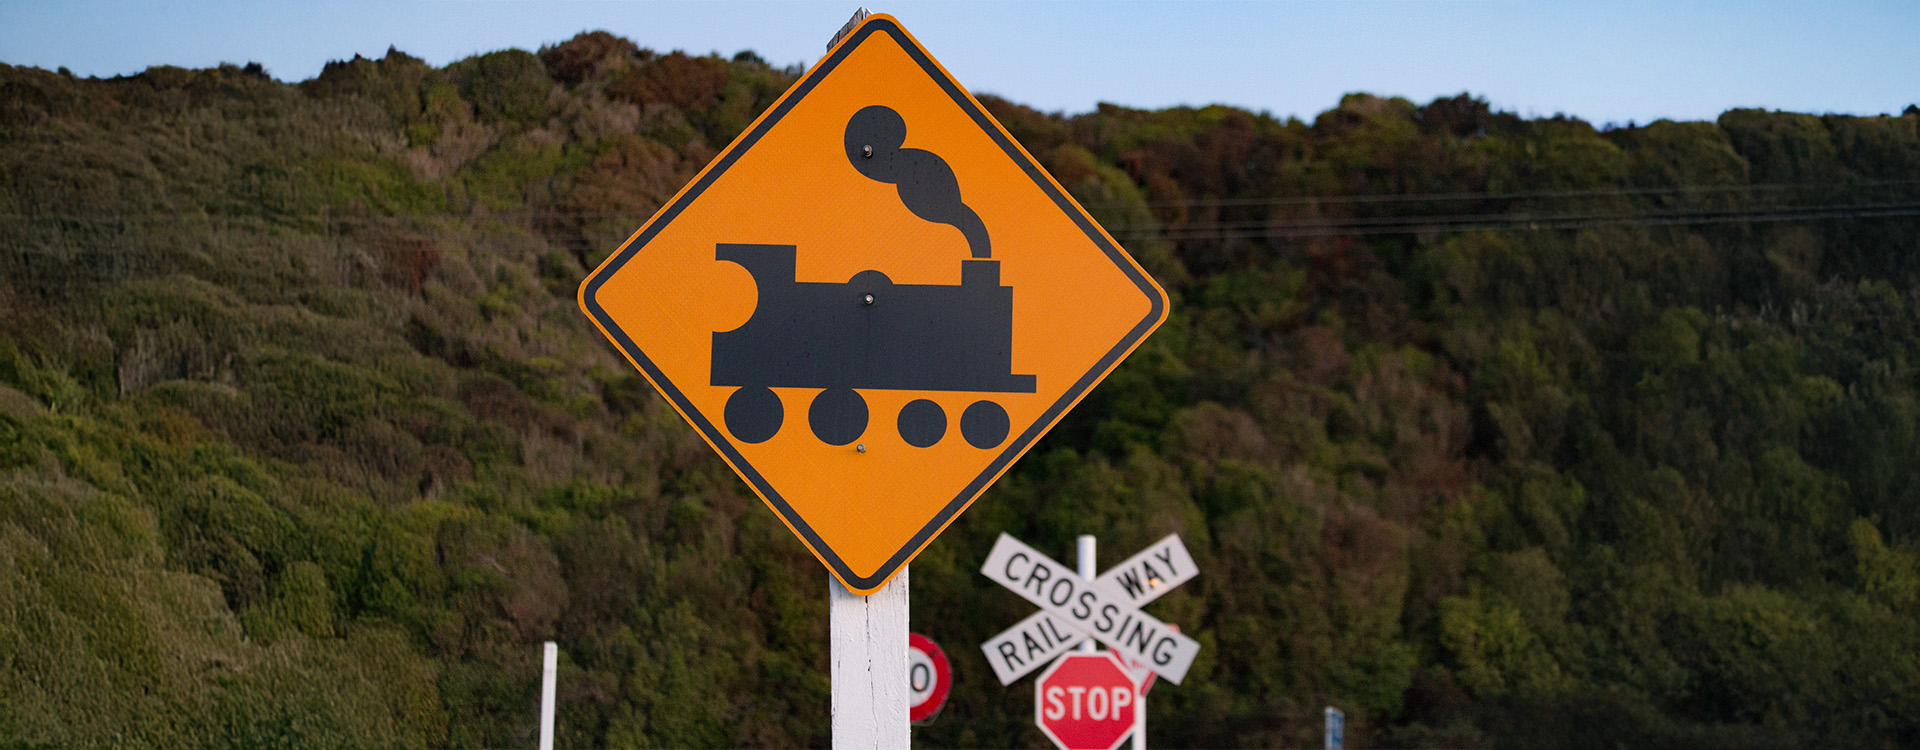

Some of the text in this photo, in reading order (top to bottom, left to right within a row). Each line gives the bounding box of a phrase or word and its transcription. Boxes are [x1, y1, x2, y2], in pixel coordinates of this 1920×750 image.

[998, 547, 1178, 672] RAIL WAY
[1005, 553, 1177, 666] CROSSING
[910, 663, 929, 692] 0
[1045, 687, 1132, 721] STOP
